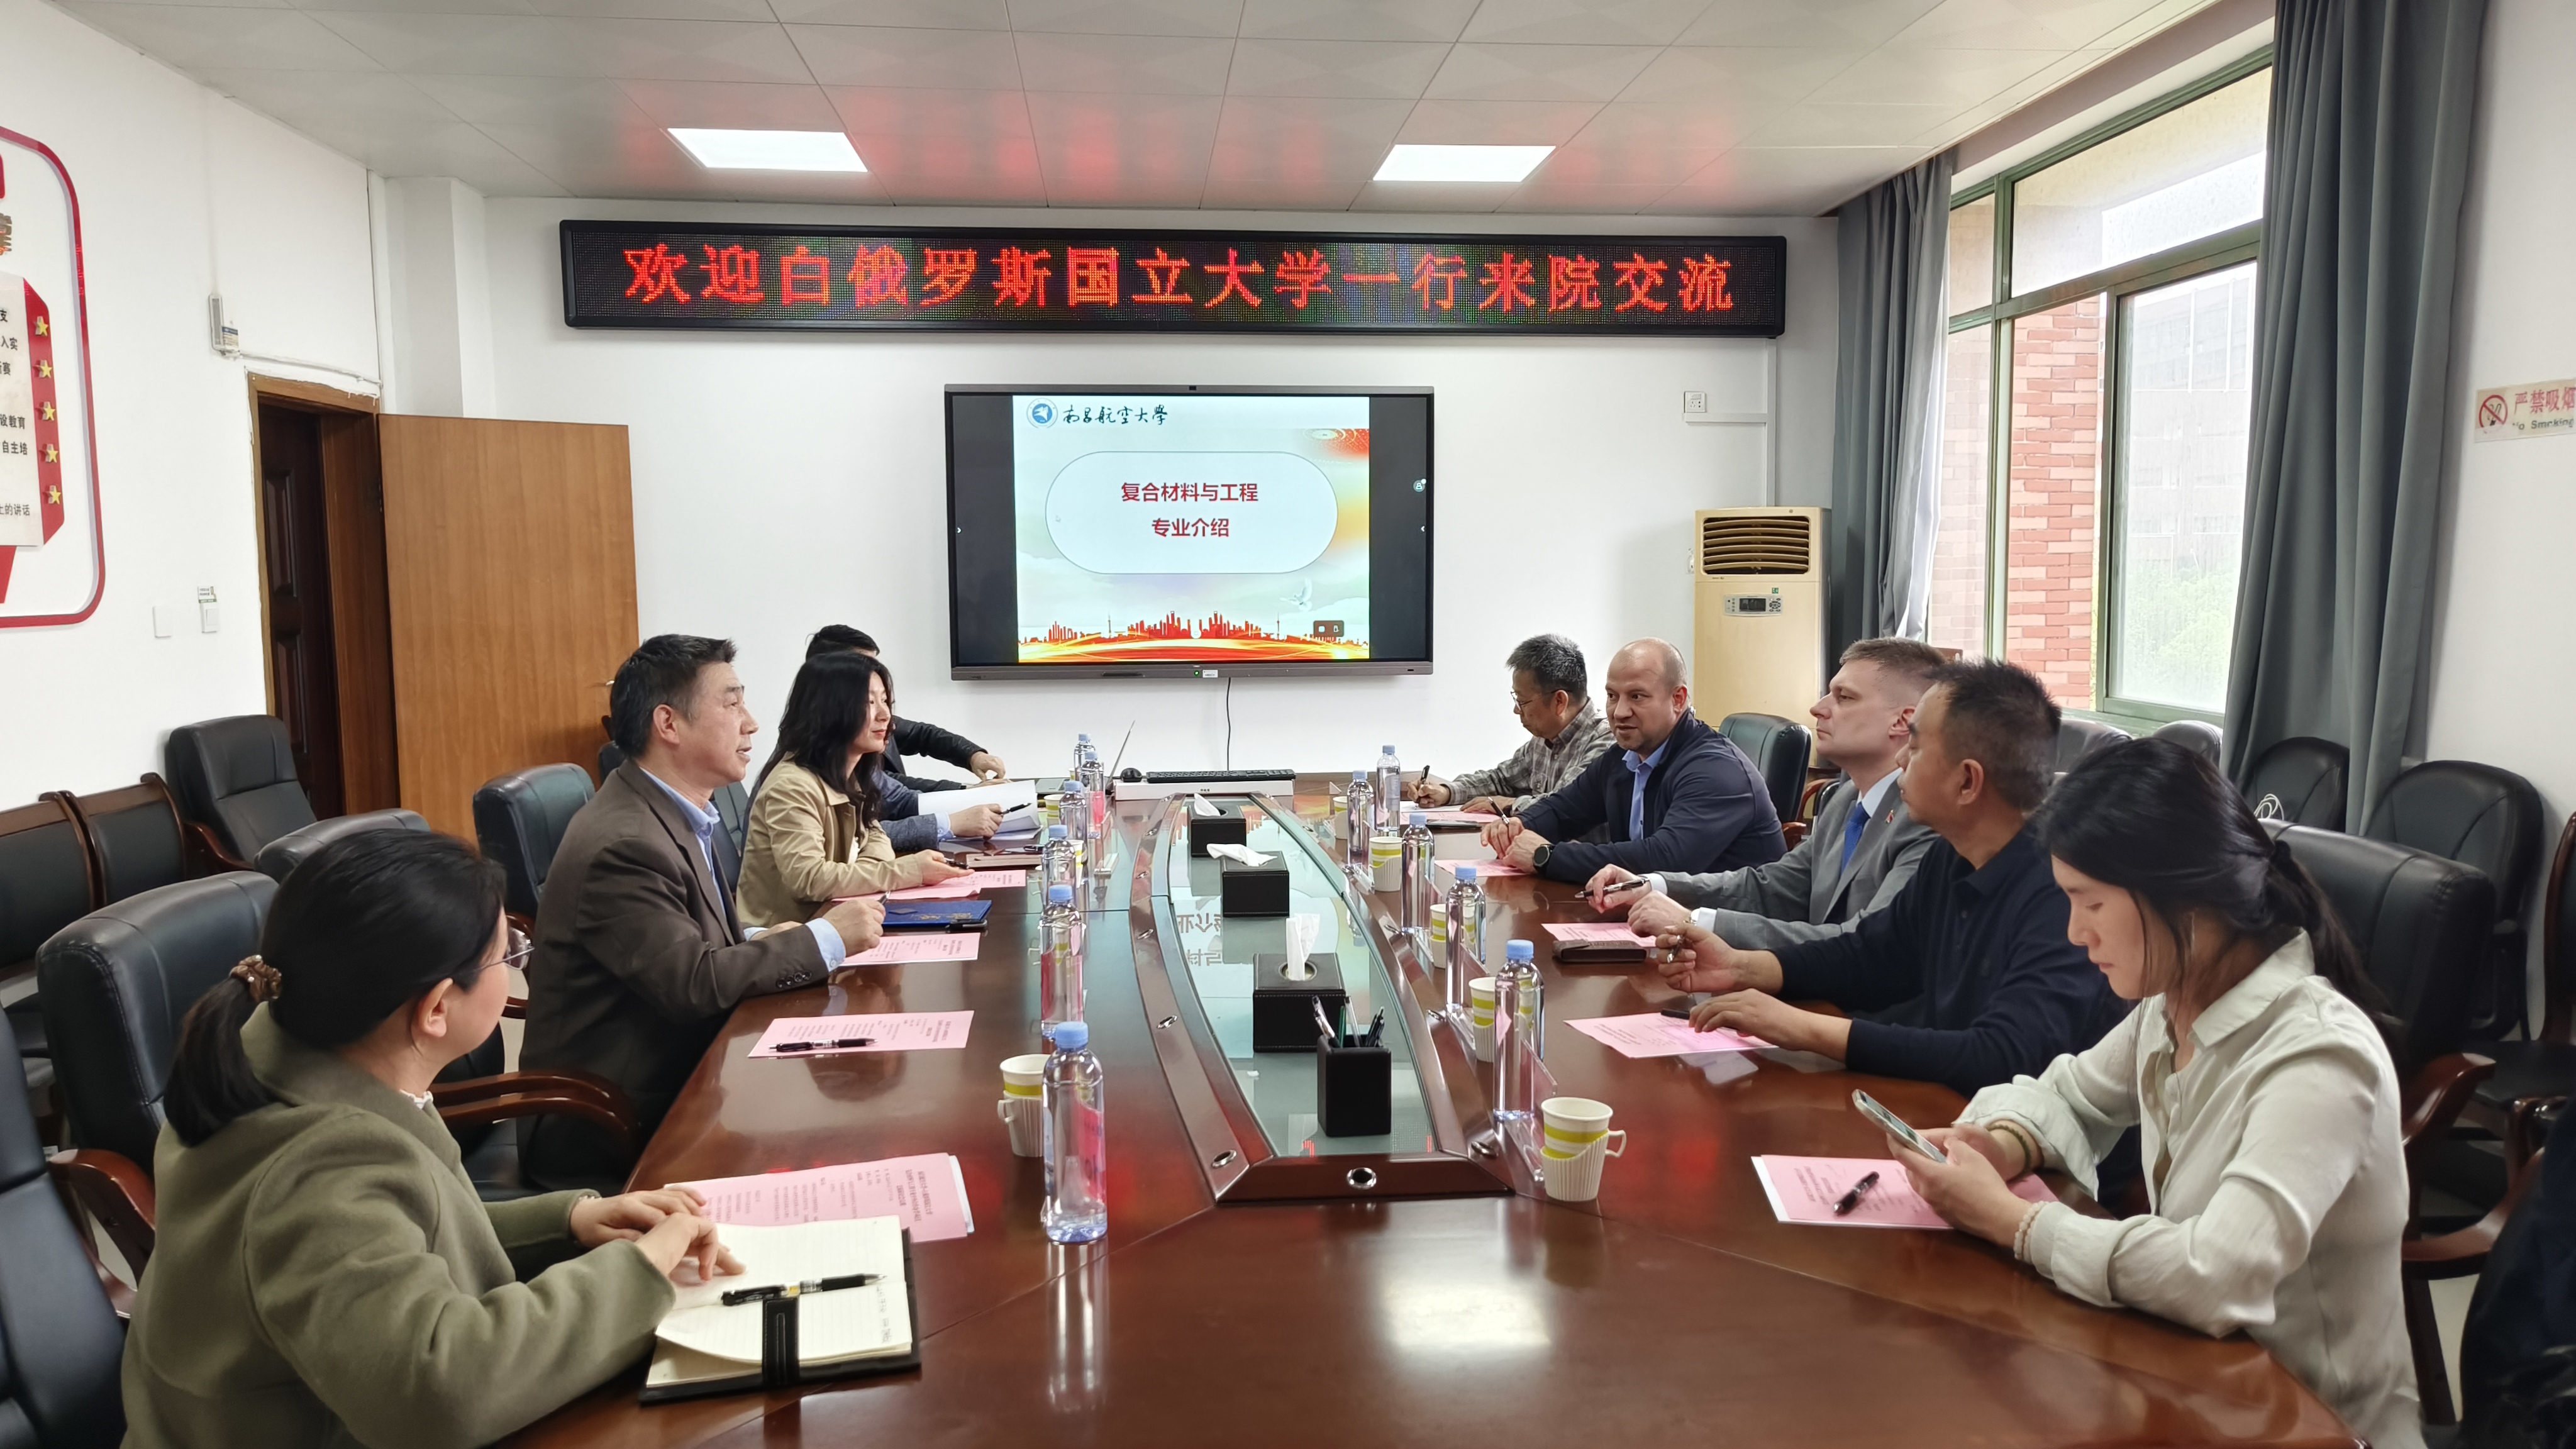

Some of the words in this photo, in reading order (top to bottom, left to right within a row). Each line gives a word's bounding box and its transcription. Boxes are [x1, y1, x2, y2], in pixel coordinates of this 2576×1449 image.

[623, 243, 1734, 313] 欢迎白俄罗斯国立大学一行来院交流
[2514, 387, 2576, 414] 严禁吸烟
[1121, 482, 1258, 502] 复合材料与工程
[1152, 518, 1230, 537] 专业介绍
